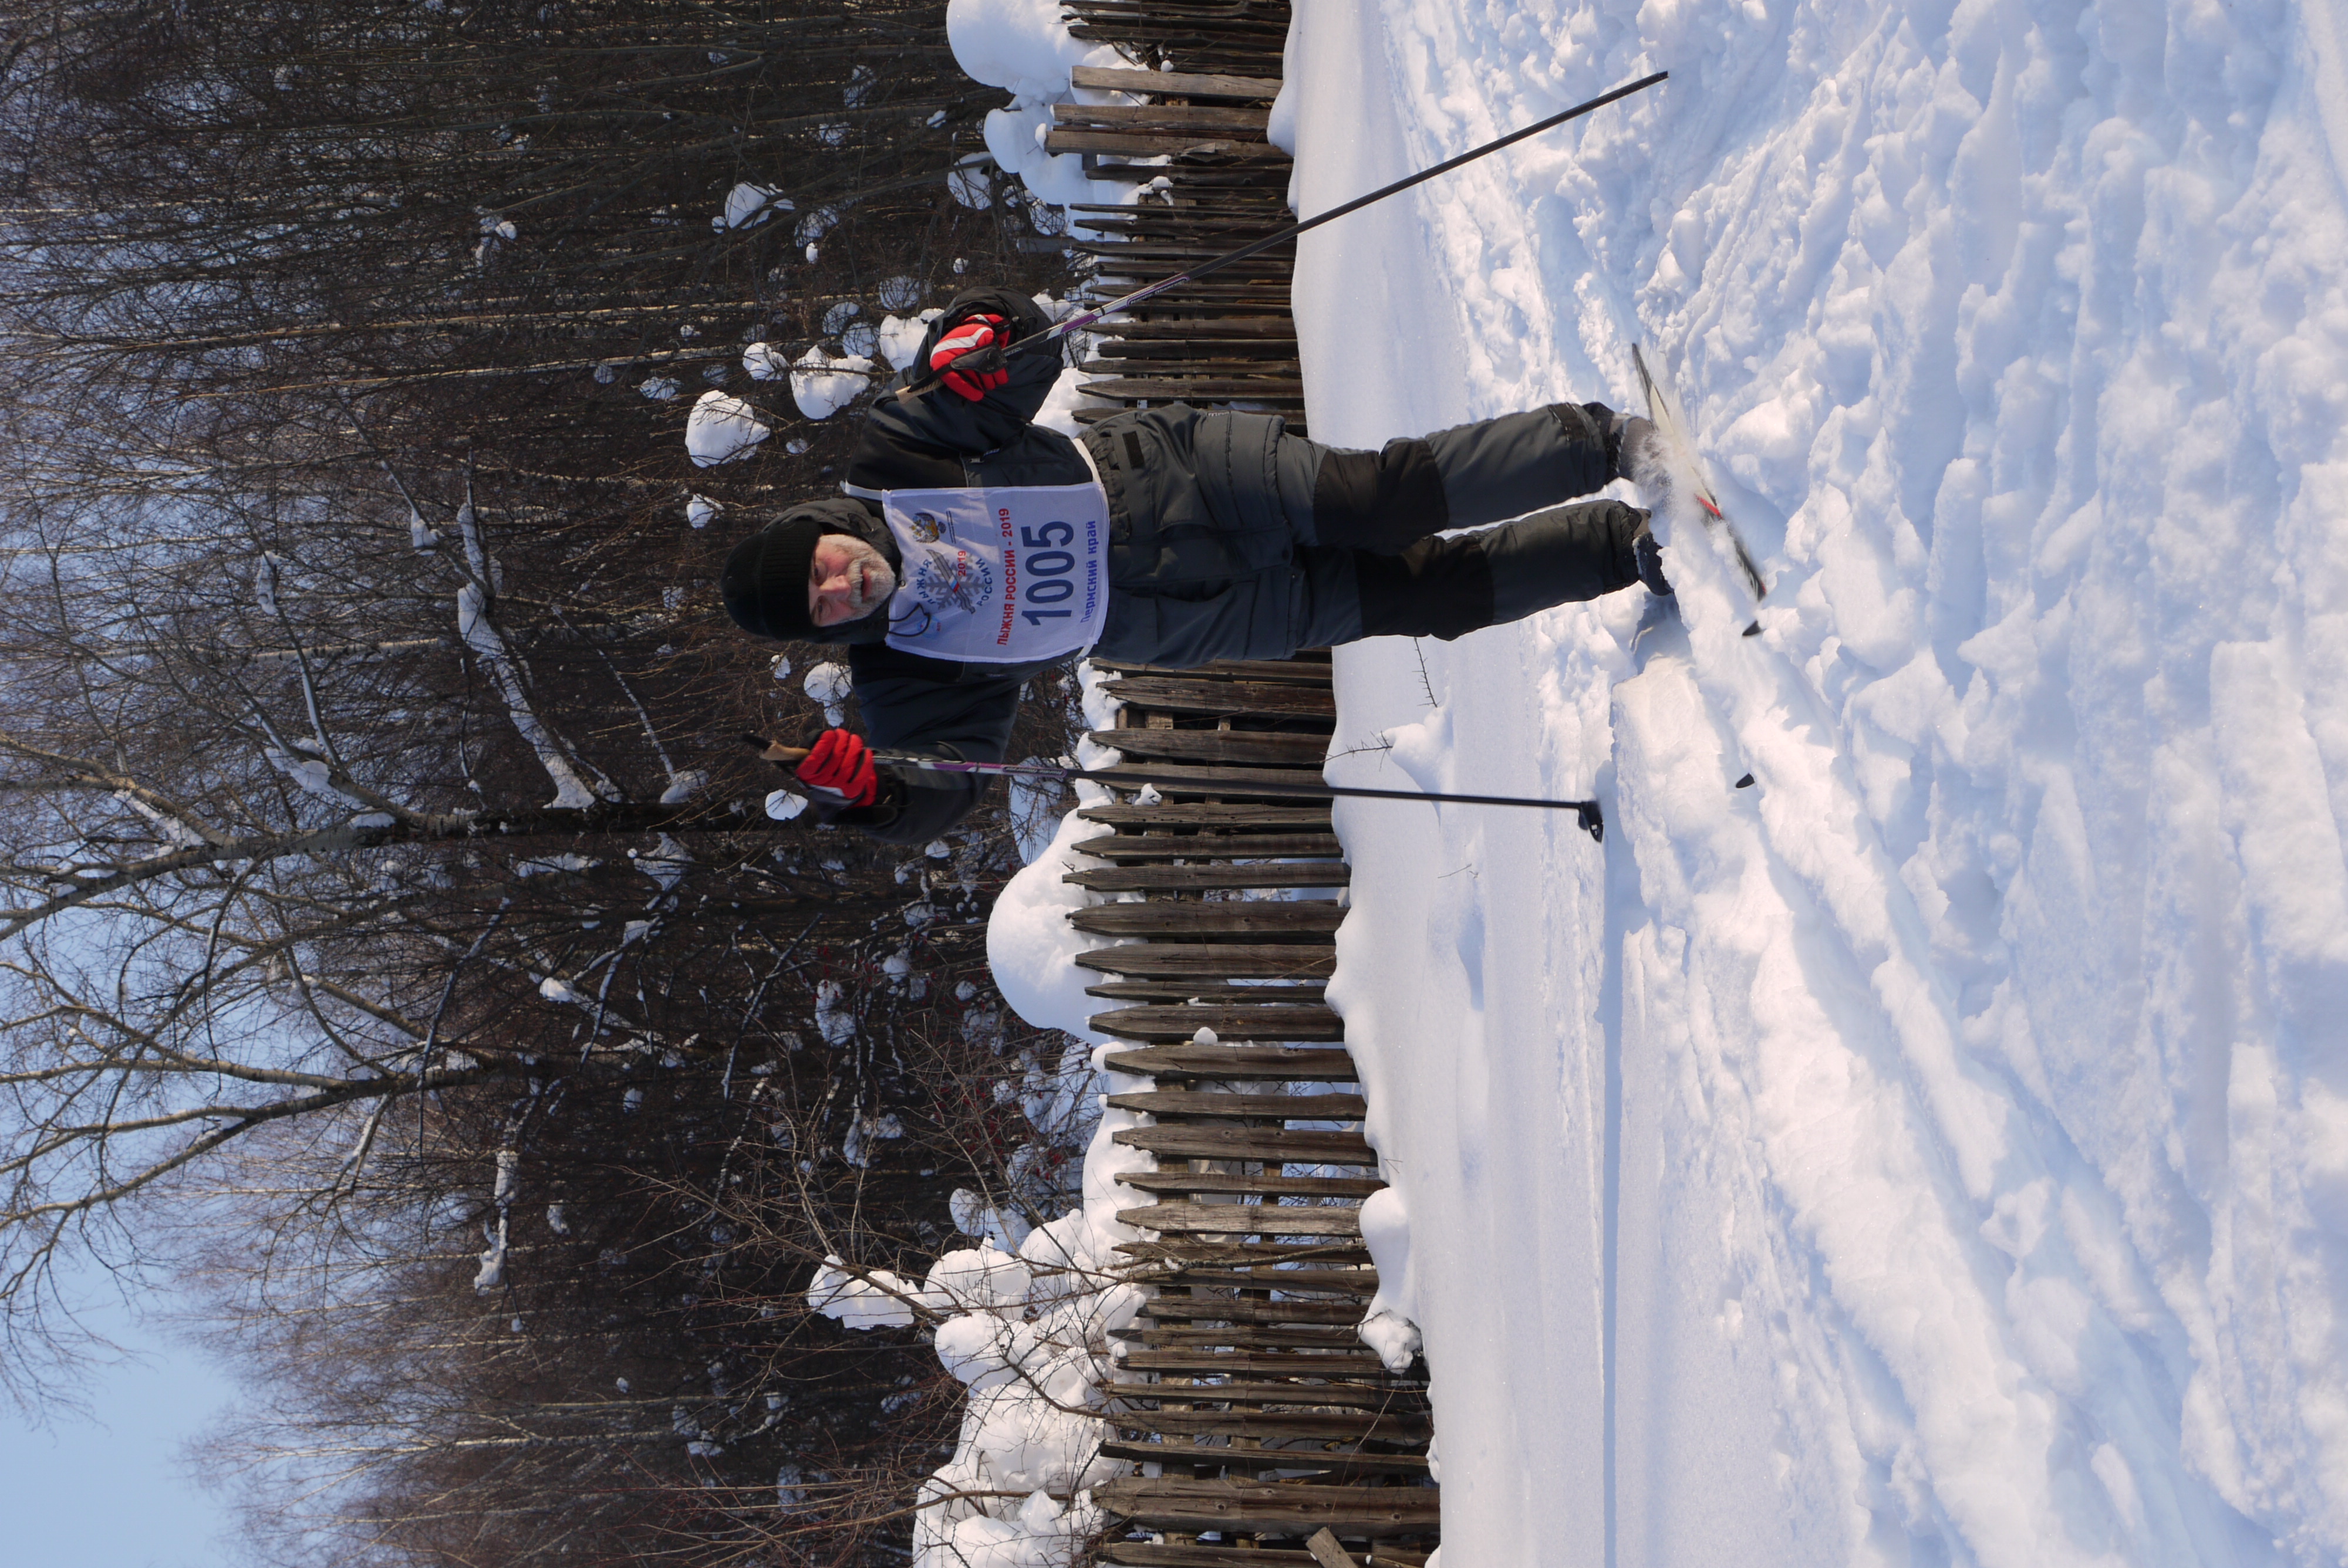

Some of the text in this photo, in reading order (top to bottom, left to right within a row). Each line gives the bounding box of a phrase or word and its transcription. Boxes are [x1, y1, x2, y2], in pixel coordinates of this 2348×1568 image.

[998, 508, 1013, 538] 2019
[916, 559, 936, 604] ЛЫЖНЯ
[957, 550, 966, 576] 2019
[976, 559, 993, 606] РОССИИ
[1005, 550, 1016, 600] РОССИИ
[1020, 521, 1075, 626] 1005
[1080, 521, 1099, 623] Пермский край
[997, 604, 1014, 645] ЛЫЖНЯ
